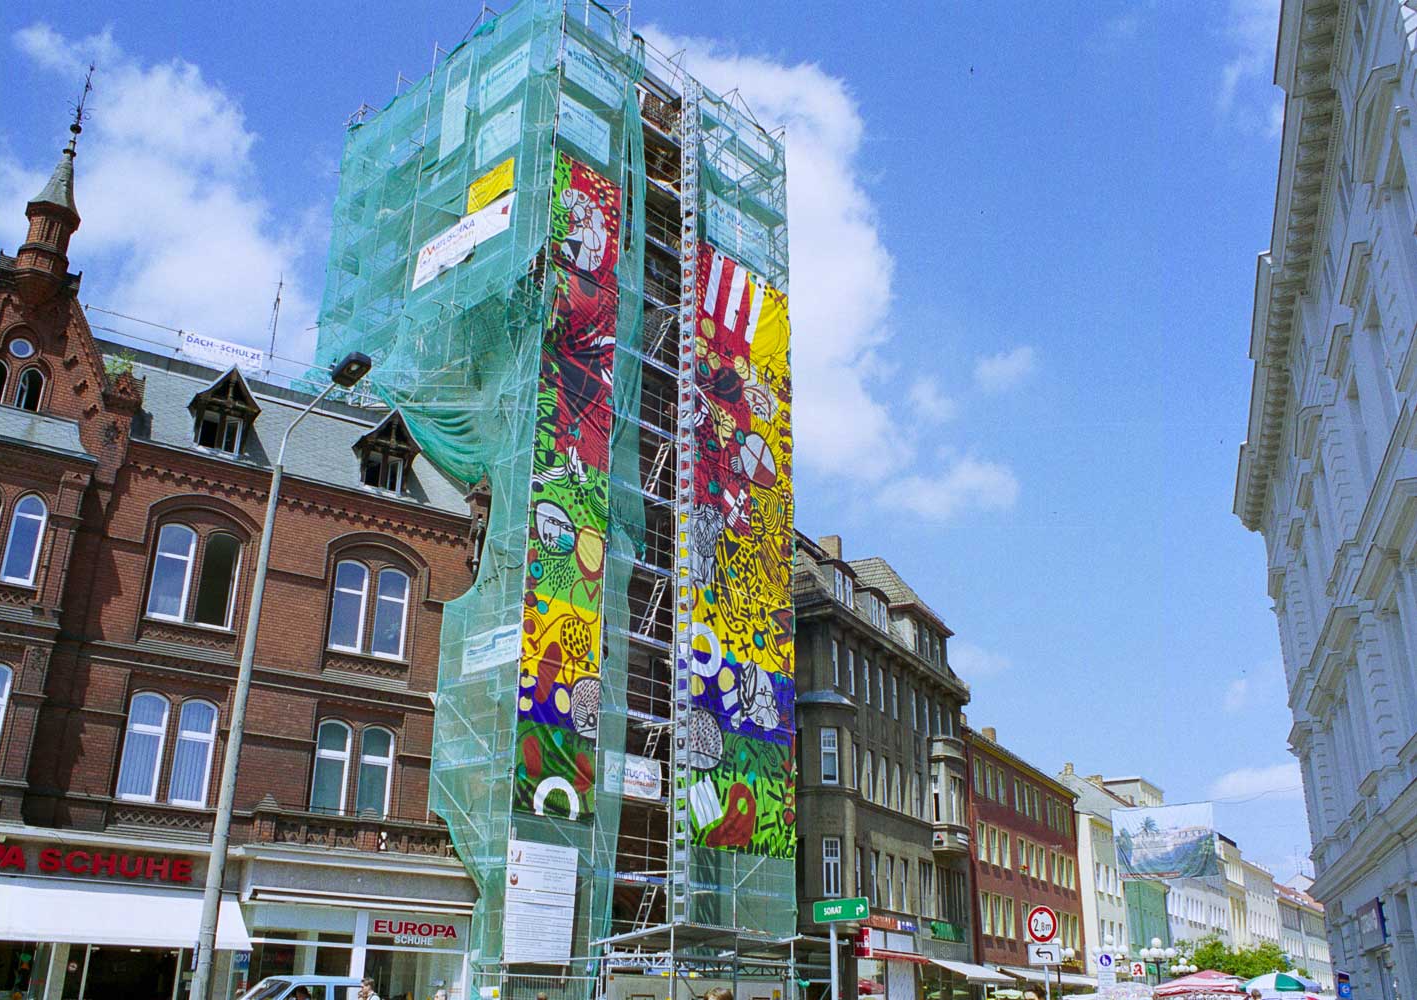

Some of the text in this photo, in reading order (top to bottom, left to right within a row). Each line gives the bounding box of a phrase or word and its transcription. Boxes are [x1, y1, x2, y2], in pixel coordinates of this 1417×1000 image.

[38, 848, 194, 882] SCHUHE
[373, 919, 458, 939] EUROPA
[394, 935, 434, 946] SCHUHE
